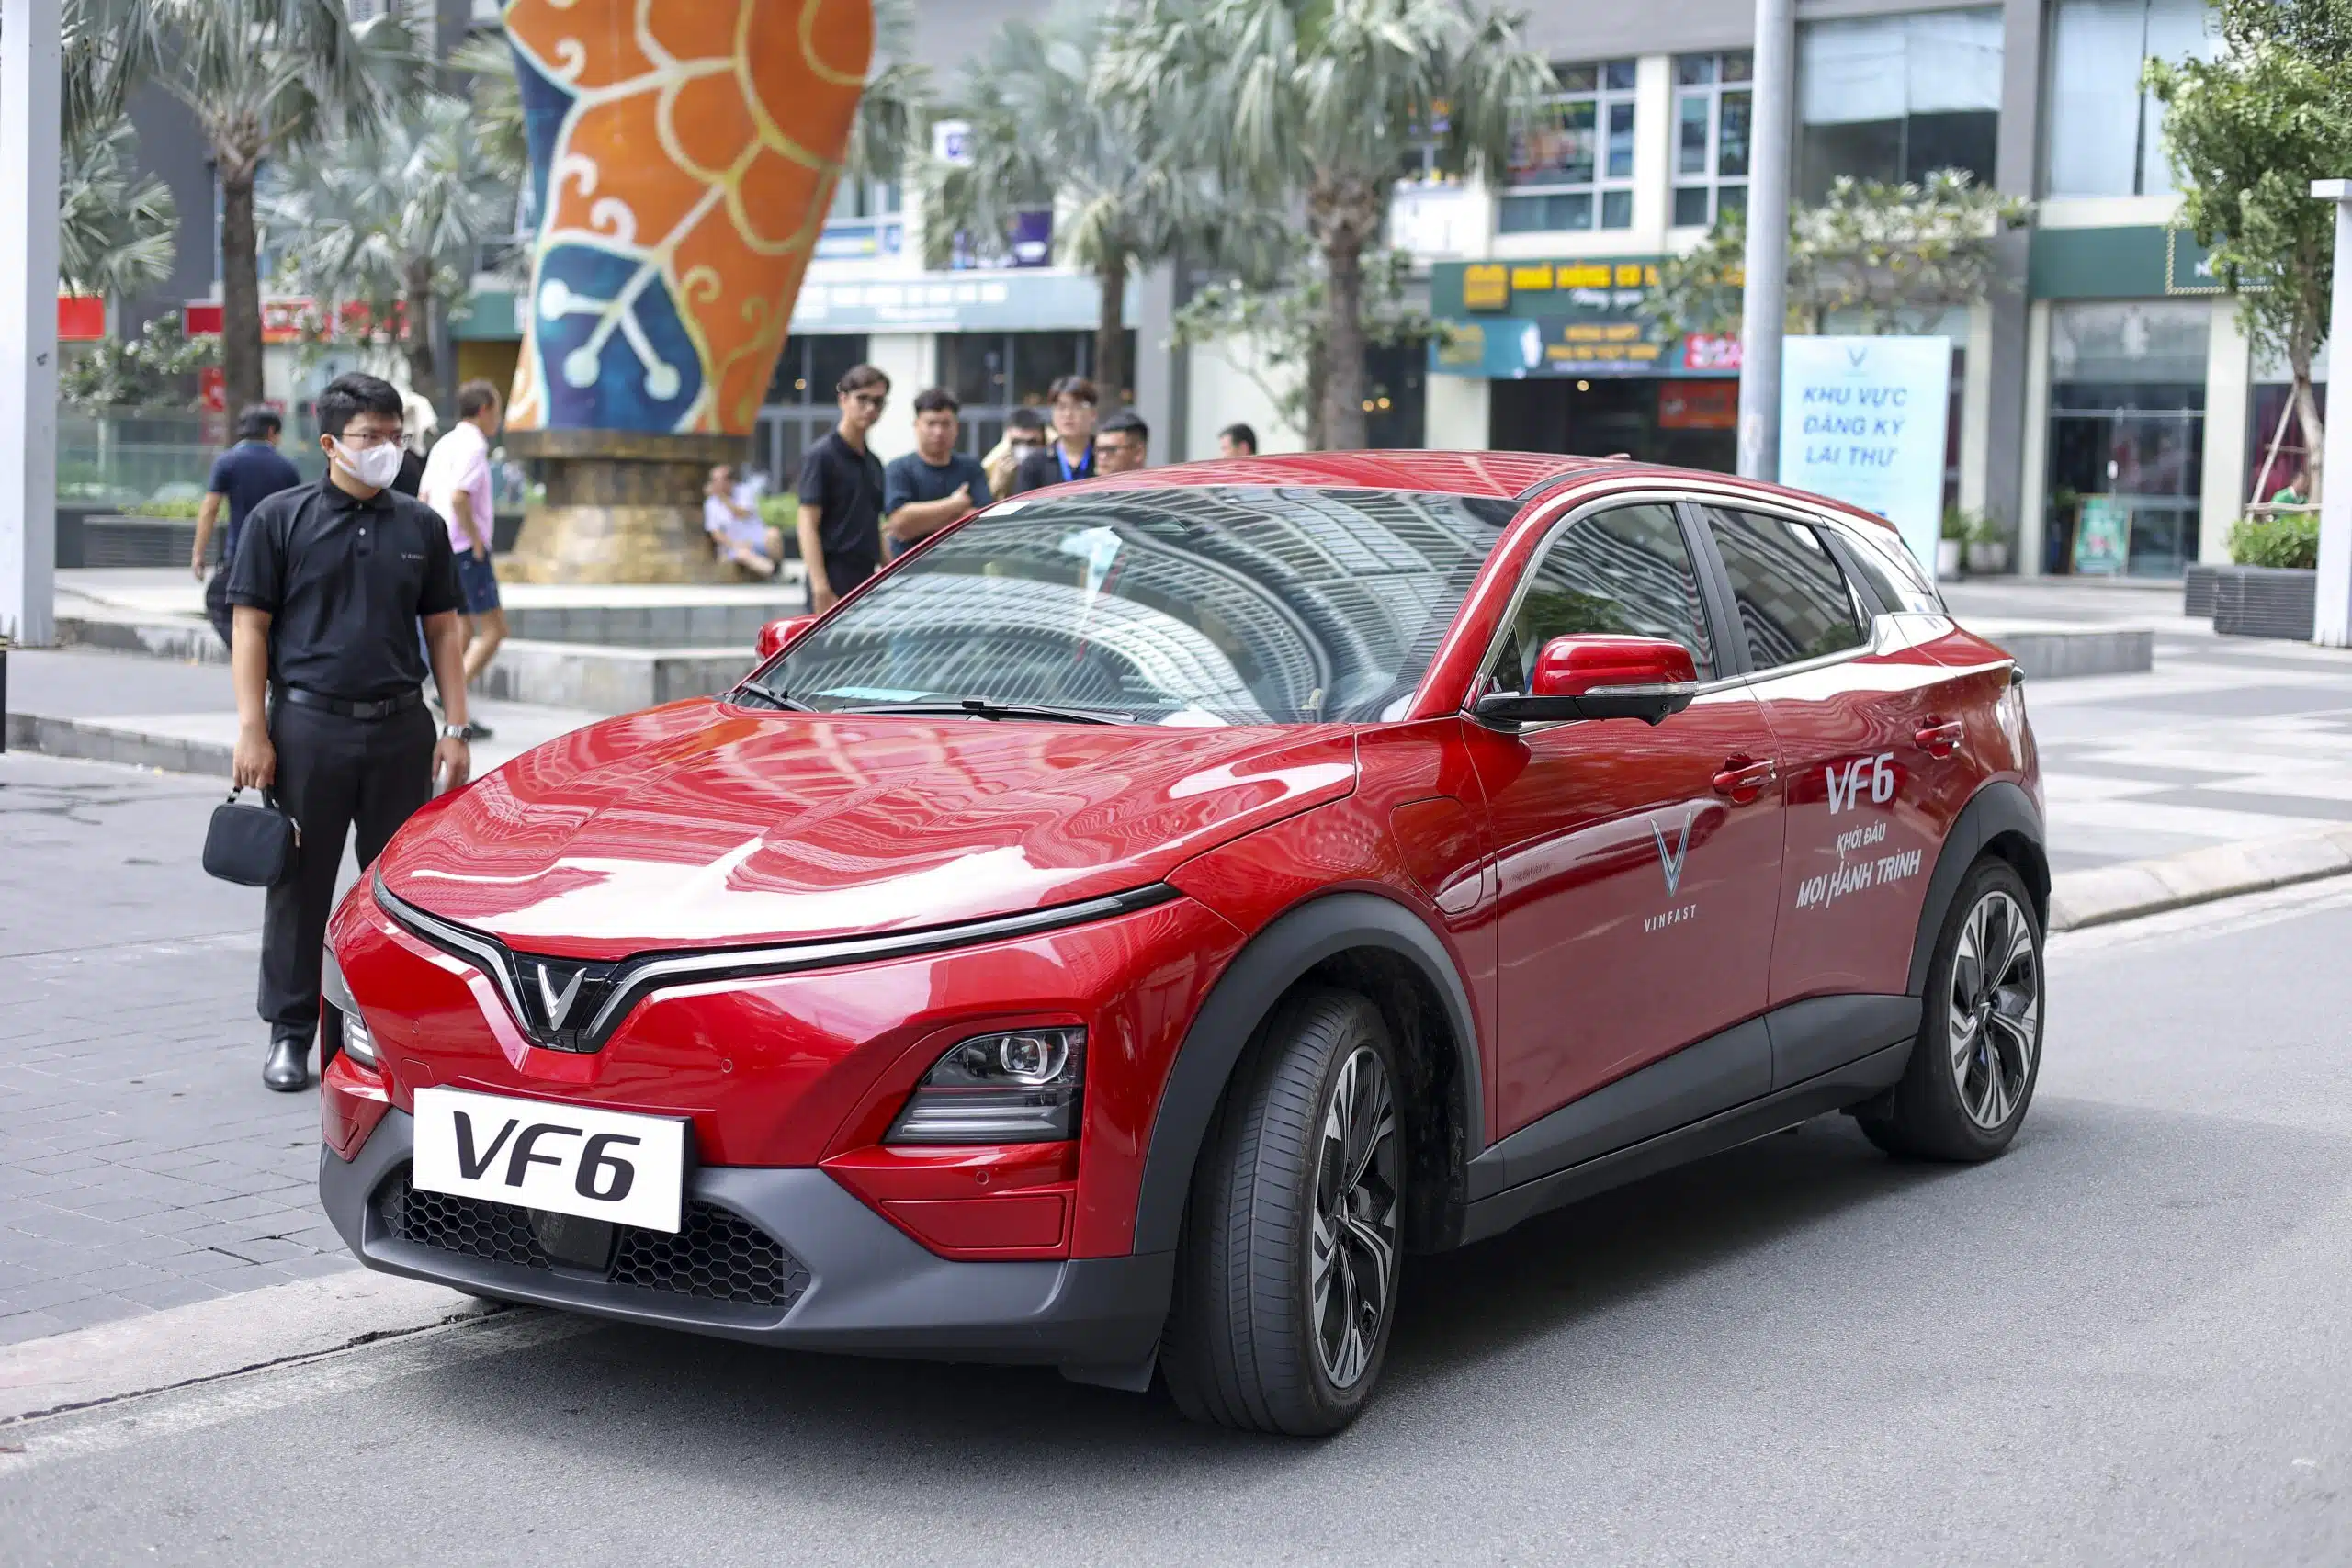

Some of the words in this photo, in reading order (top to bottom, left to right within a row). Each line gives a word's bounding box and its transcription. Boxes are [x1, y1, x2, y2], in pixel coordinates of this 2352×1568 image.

[1803, 386, 1851, 404] KHU
[1825, 751, 1894, 816] VF6
[1795, 874, 1828, 910] MỌI
[1826, 861, 1873, 908] HÀNH
[1876, 847, 1922, 885] TRÌNH
[1644, 904, 1696, 933] VINFAST
[453, 1111, 641, 1201] VF6
